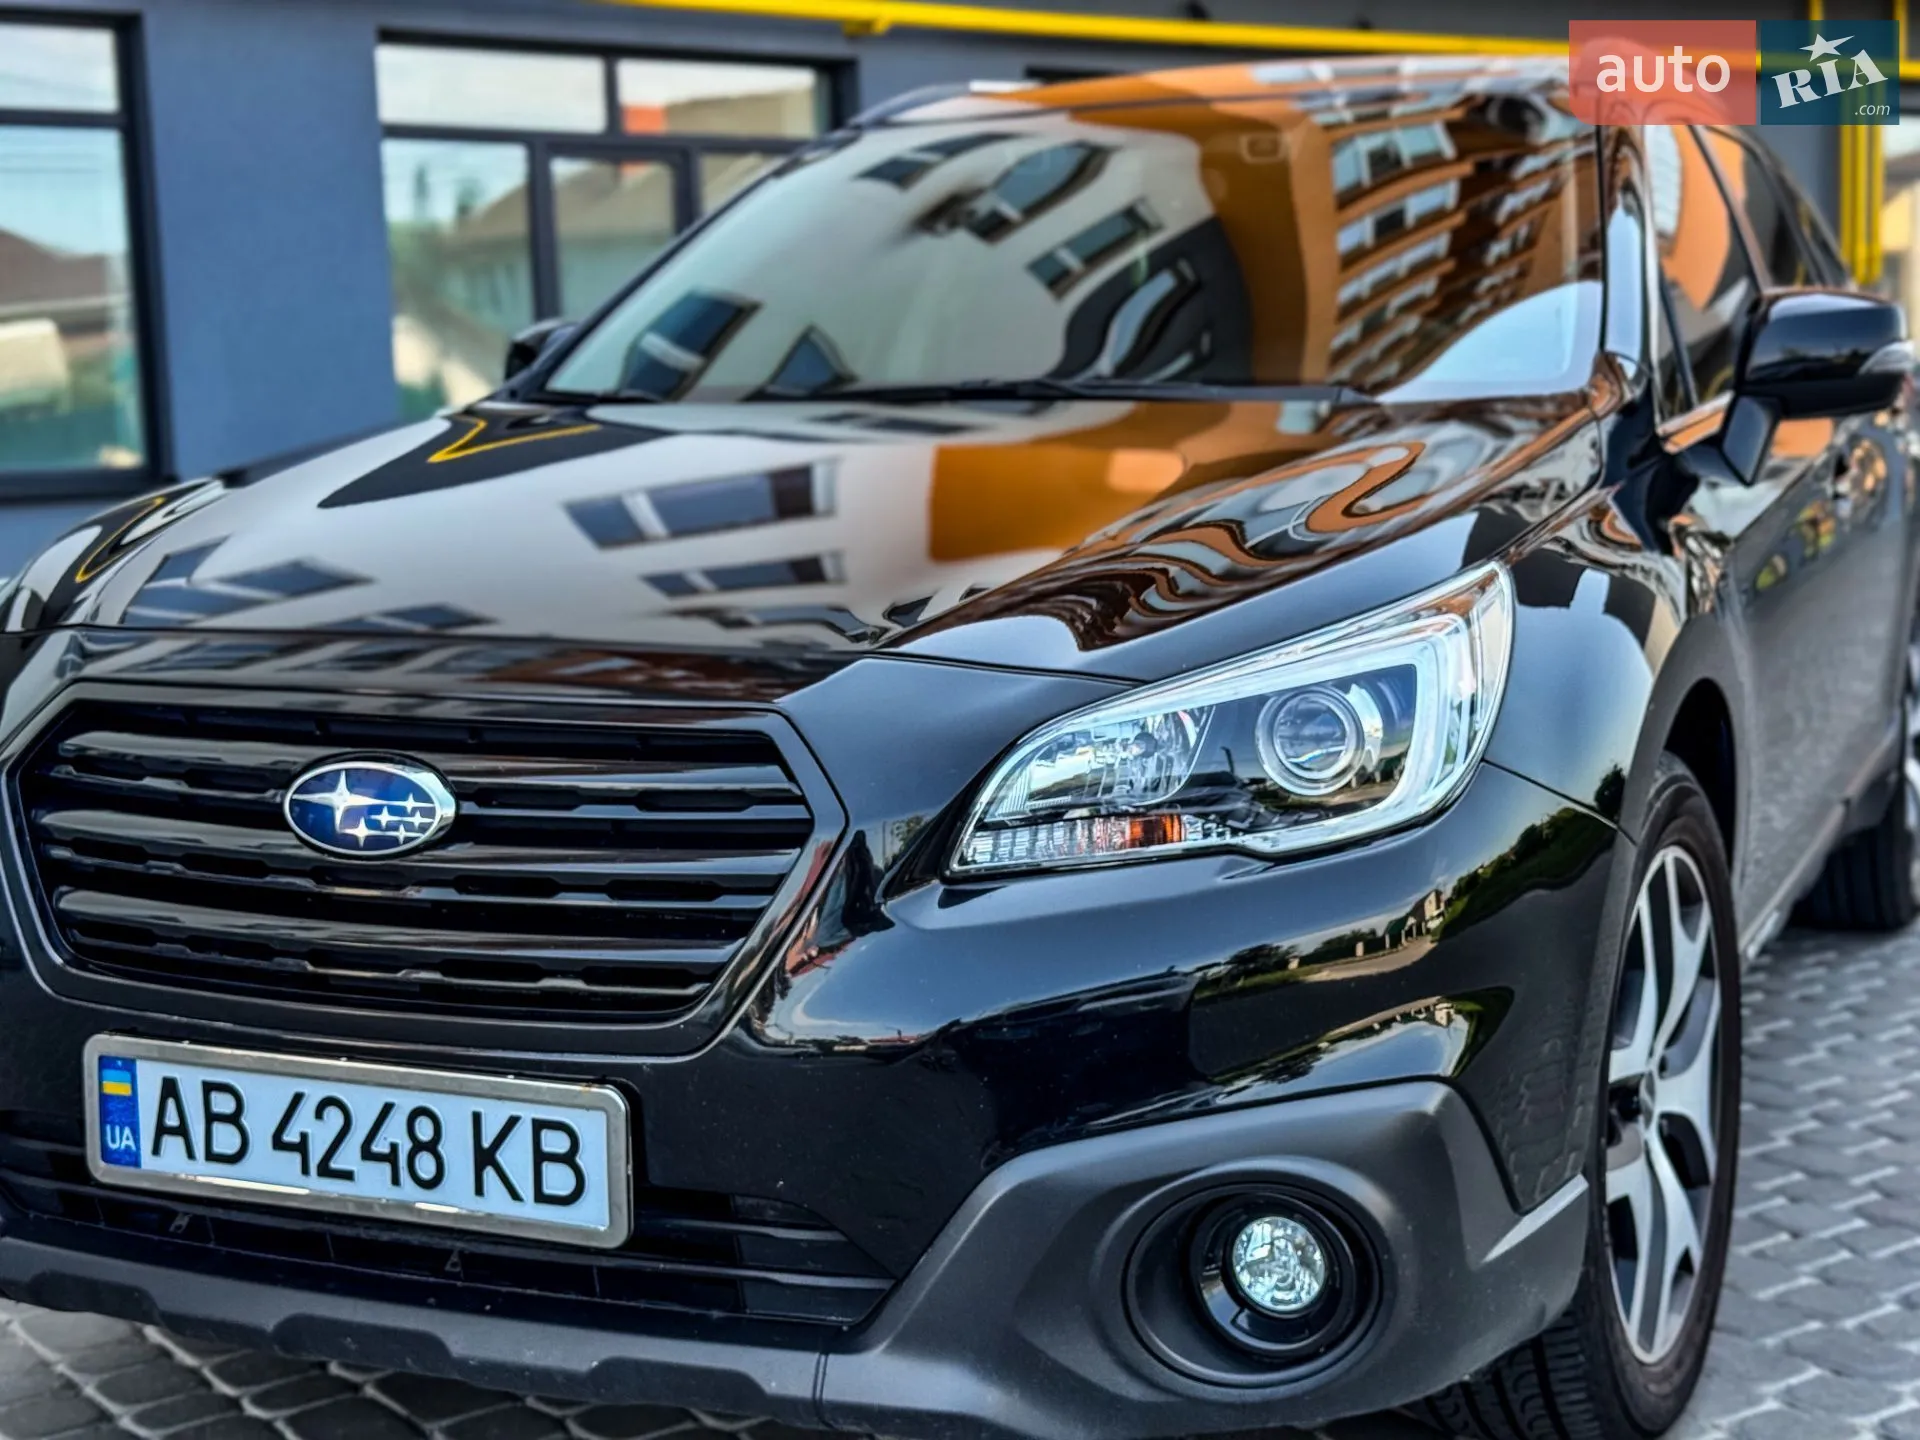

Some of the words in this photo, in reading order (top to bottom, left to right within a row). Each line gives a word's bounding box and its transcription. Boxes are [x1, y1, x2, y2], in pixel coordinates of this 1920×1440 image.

[105, 1124, 137, 1153] UA
[152, 1076, 250, 1165] AB
[272, 1091, 446, 1190] 4248
[472, 1110, 587, 1206] KB
